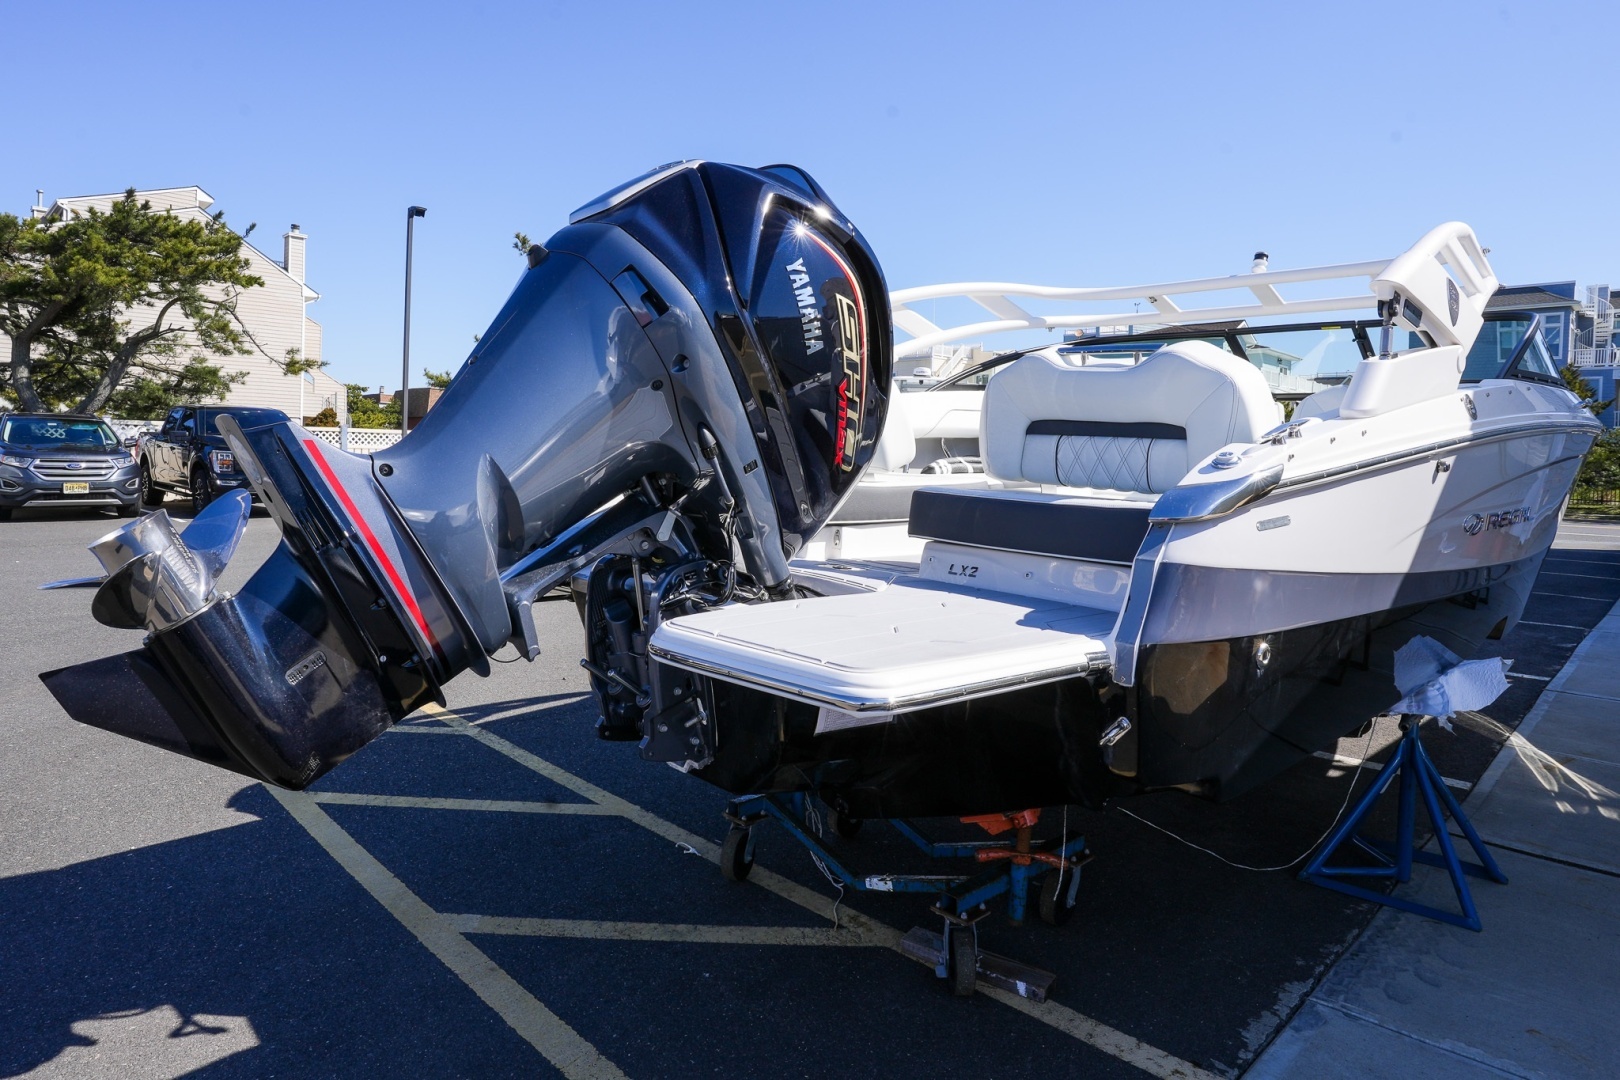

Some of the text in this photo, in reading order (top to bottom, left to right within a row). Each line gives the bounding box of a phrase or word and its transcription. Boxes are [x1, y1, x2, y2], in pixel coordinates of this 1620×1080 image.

[786, 258, 824, 355] YAMAHA
[835, 293, 860, 472] SHO
[948, 564, 979, 578] LX2
